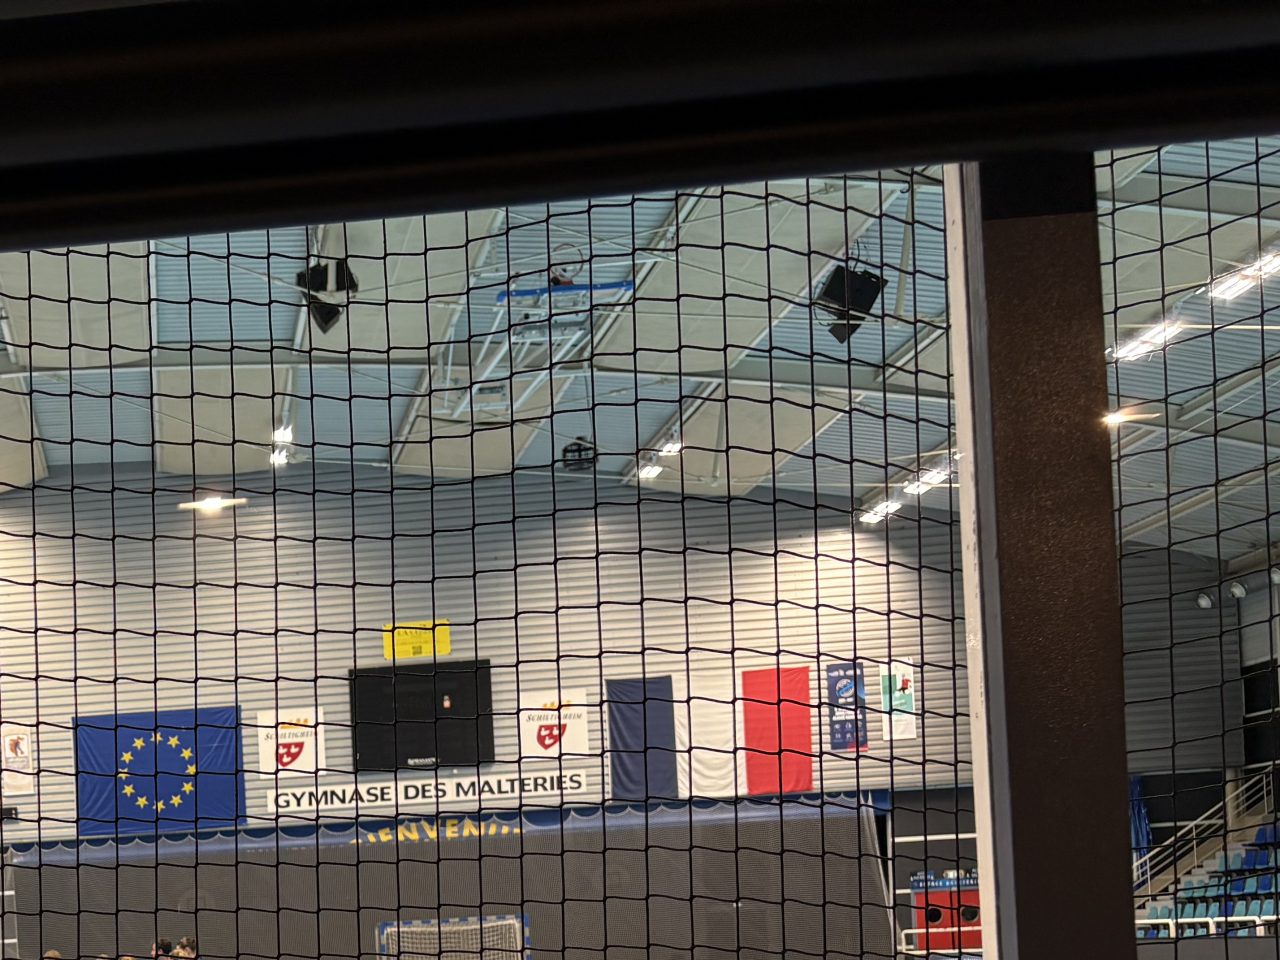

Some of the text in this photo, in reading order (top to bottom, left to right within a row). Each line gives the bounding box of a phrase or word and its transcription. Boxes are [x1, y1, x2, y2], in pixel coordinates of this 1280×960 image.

[525, 712, 583, 722] SCHILTIHEIM
[264, 729, 320, 741] SCILTIGHEI
[274, 773, 582, 809] GYMNASE DES MALTERIES
